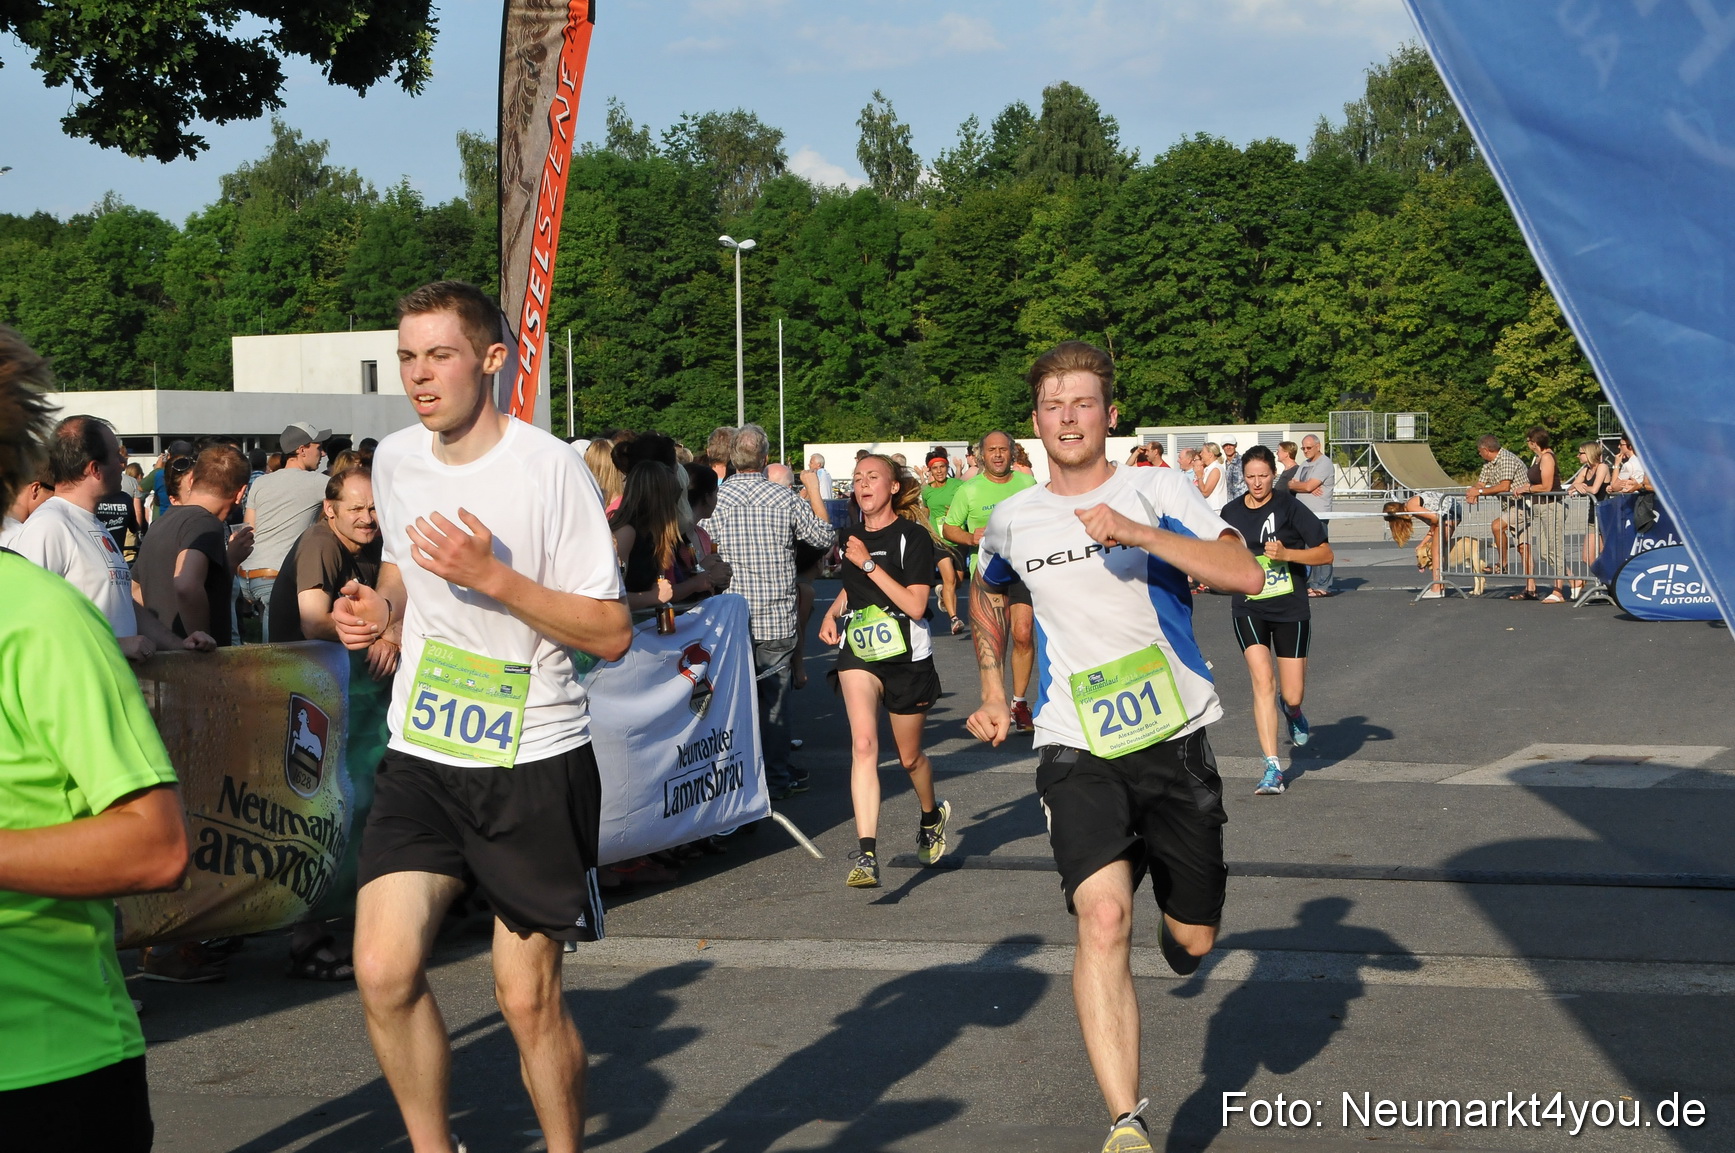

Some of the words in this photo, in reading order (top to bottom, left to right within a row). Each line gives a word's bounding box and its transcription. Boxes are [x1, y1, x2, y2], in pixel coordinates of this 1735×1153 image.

[1026, 543, 1138, 573] DELPH
[1661, 596, 1716, 605] AUTOMO
[427, 645, 454, 661] 2014
[853, 622, 892, 649] 976
[412, 690, 513, 750] 5104
[1093, 680, 1162, 737] 201
[1145, 720, 1158, 730] Bock
[675, 727, 734, 771] Neumarkter
[293, 769, 312, 790] 1628
[663, 755, 744, 819] Lammsbräu
[217, 775, 346, 863] Neumarkte
[192, 827, 330, 907] ammsb
